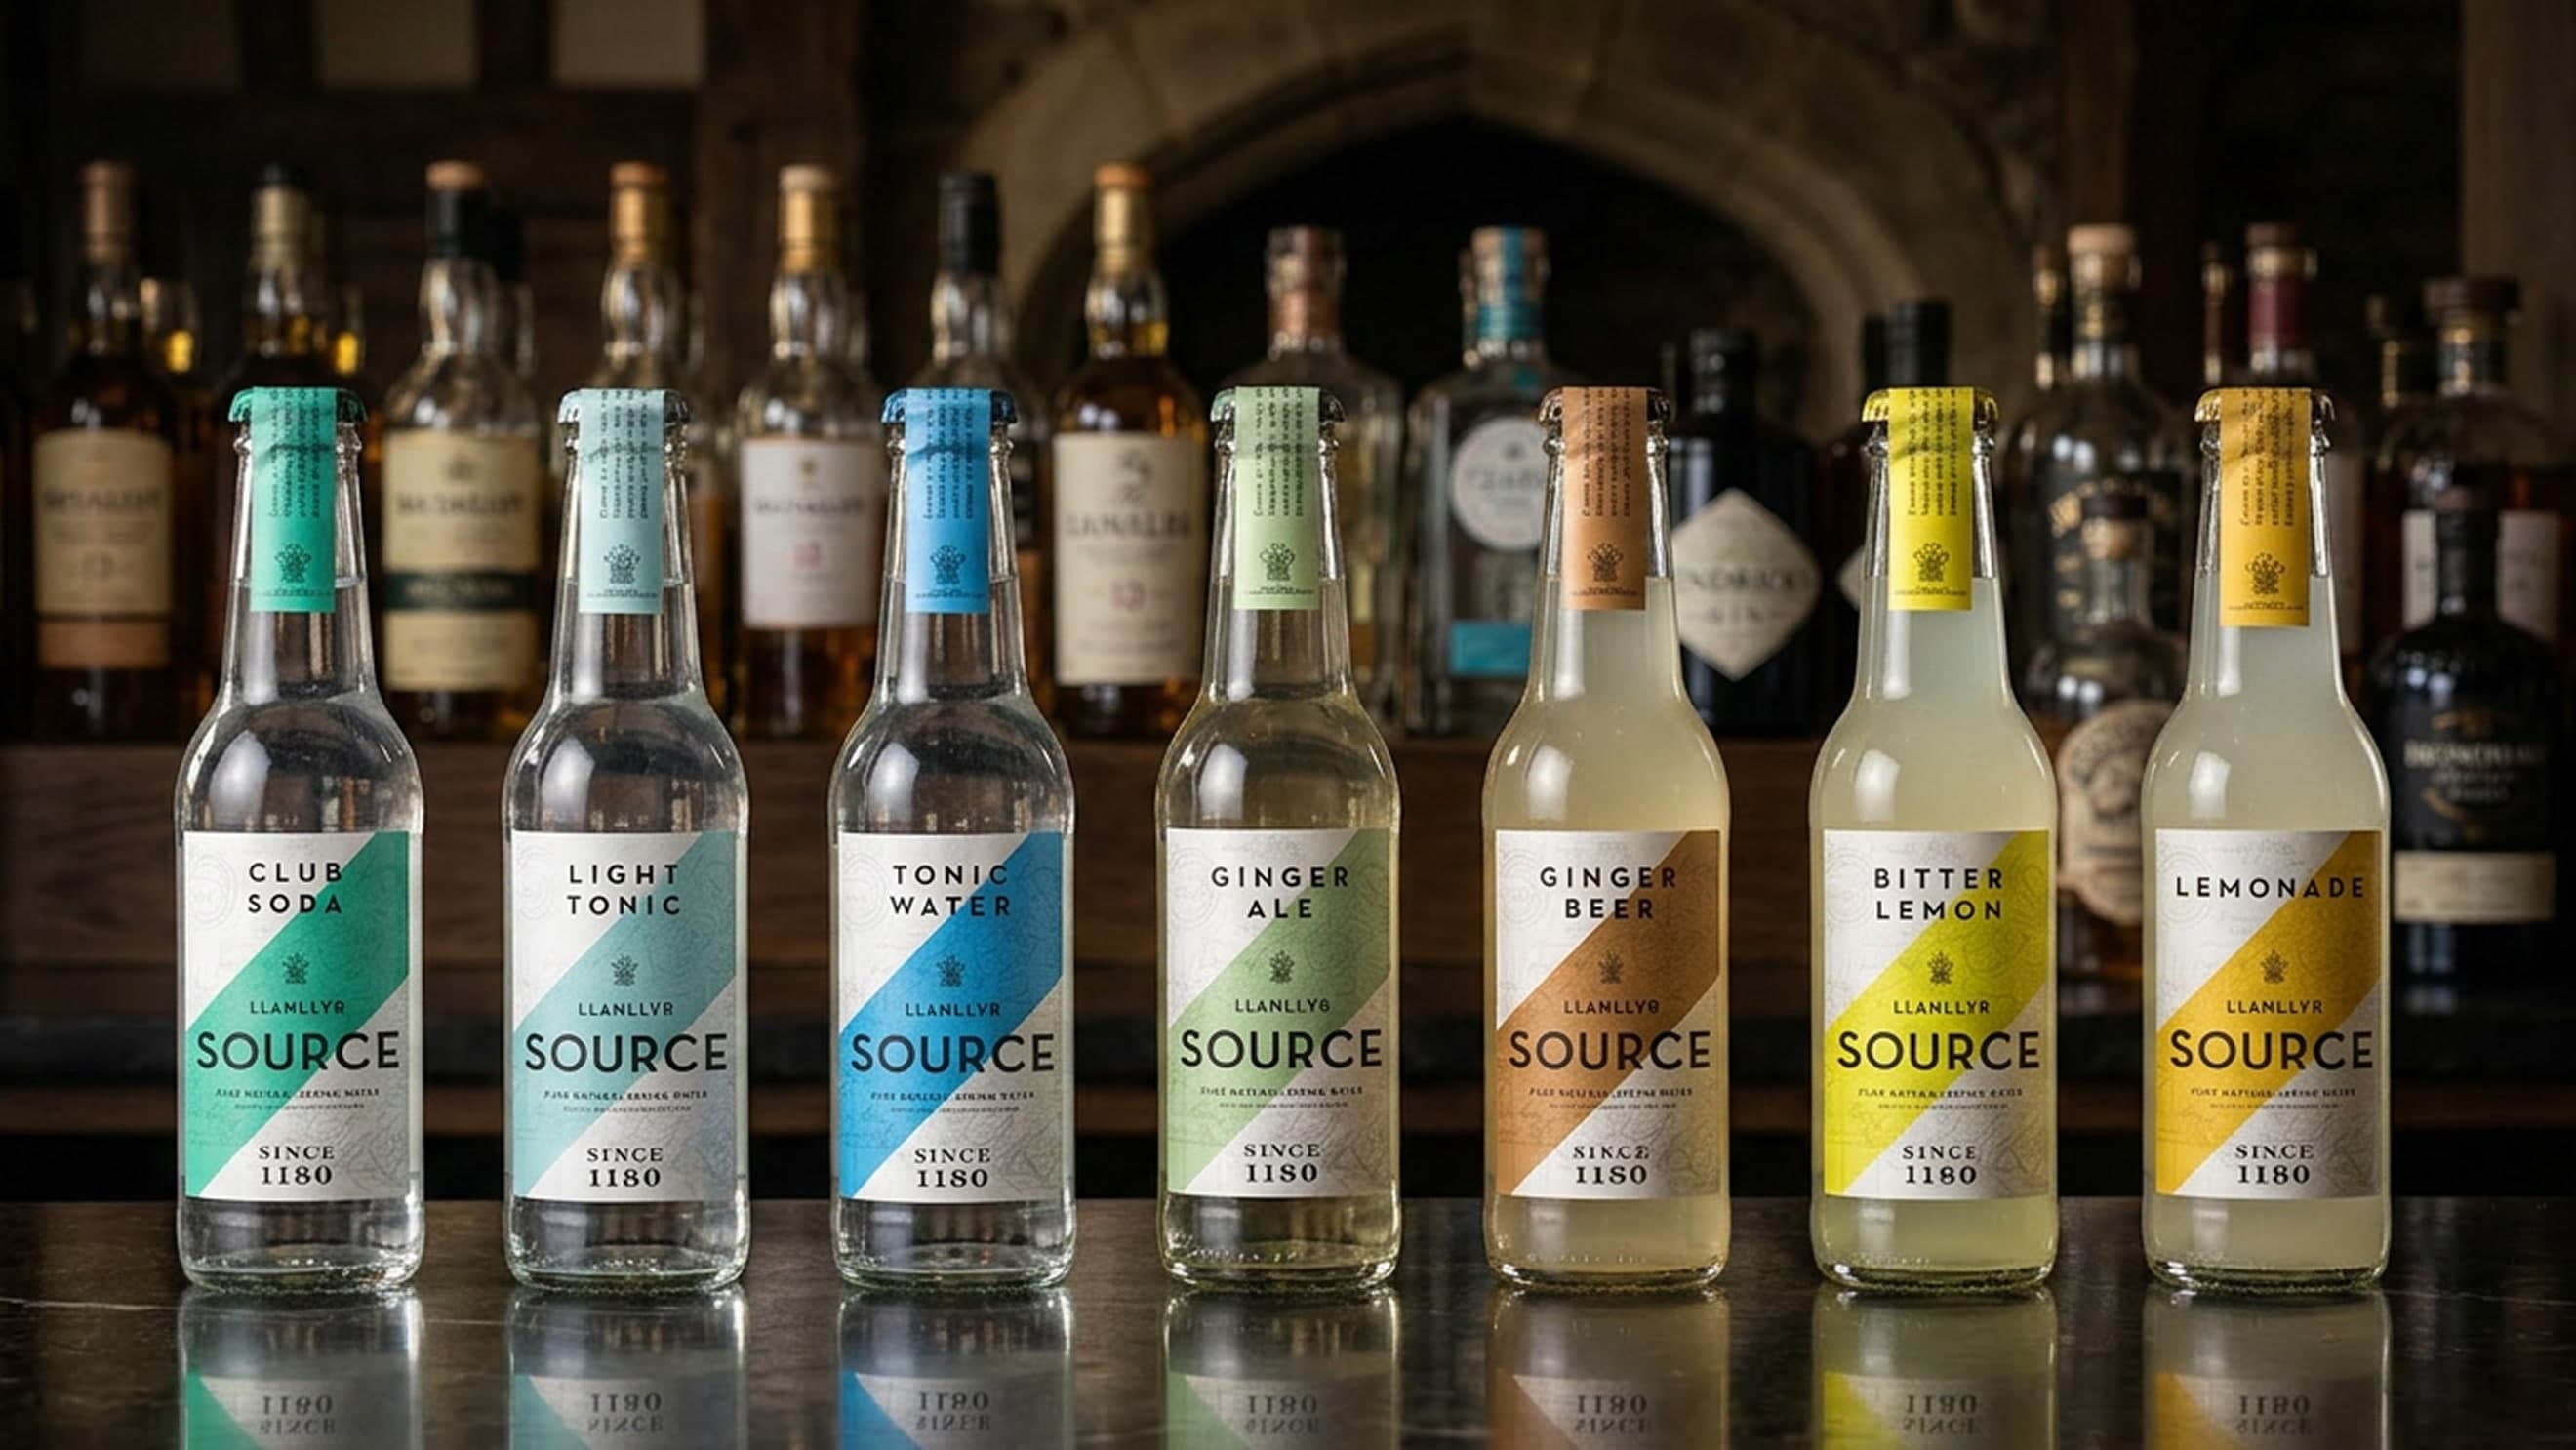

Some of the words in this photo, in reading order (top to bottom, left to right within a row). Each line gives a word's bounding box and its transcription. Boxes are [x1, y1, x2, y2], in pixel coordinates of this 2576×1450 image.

[249, 863, 343, 882] CLUB
[570, 865, 677, 884] LIGHT
[893, 865, 1008, 885] TONIC
[1212, 866, 1349, 887] GINGER
[1541, 867, 1677, 888] GINGER
[1875, 868, 2001, 889] BITTER
[2177, 877, 2364, 898] LEMONADE
[249, 894, 343, 913] SODA
[567, 896, 679, 915] TONIC
[890, 896, 1010, 916] WATER
[1247, 899, 1311, 918] ALE
[1566, 899, 1654, 918] BEER
[1877, 901, 2003, 920] LEMON
[197, 1031, 399, 1070] SOURCE
[526, 1033, 727, 1072] SOURCE
[852, 1033, 1054, 1073] SOURCE
[1181, 1029, 1381, 1068] SOURCE
[1509, 1030, 1710, 1070] SOURCE
[1838, 1031, 2038, 1070] SOURCE
[2171, 1029, 2374, 1069] SOURCE
[260, 1147, 336, 1160] SINCE
[587, 1148, 662, 1163] SINCE
[915, 1148, 991, 1163] SINCE
[1244, 1144, 1319, 1158] SINCE
[1903, 1146, 1975, 1160] SINCE
[2235, 1145, 2314, 1159] SINCE
[262, 1165, 332, 1185] 1180
[590, 1168, 660, 1187] 1180
[1907, 1165, 1976, 1185] 1180
[2239, 1165, 2309, 1184] 1180
